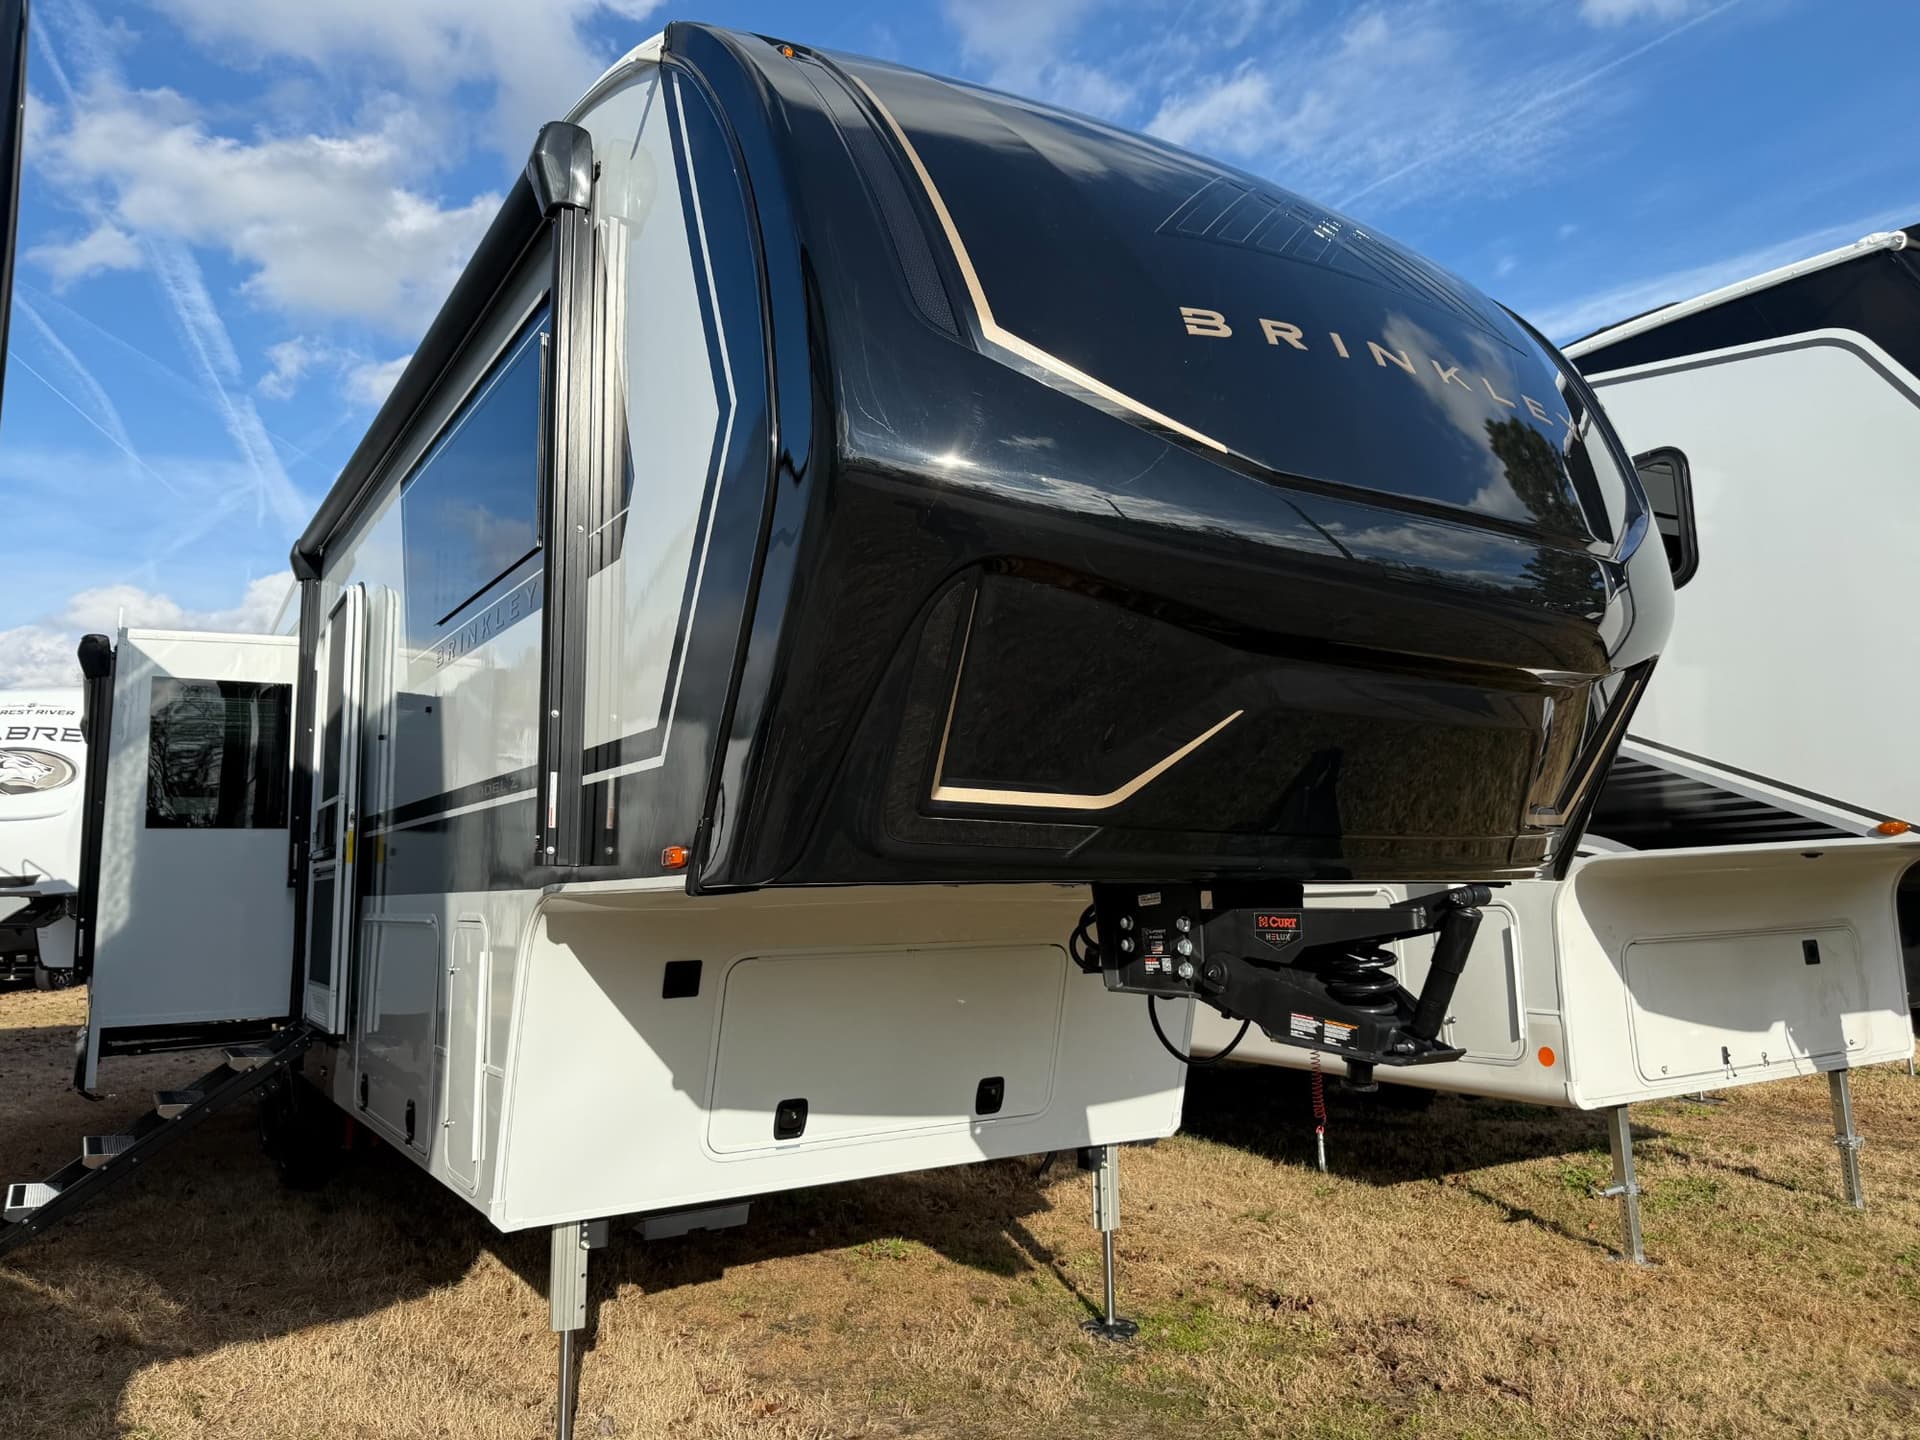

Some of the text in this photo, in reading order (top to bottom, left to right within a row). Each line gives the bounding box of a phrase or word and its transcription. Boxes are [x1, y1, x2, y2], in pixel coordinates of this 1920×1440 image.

[1179, 306, 1581, 442] BRINKLEY
[435, 582, 538, 669] BRINKLEY
[35, 709, 76, 717] RIVER
[0, 726, 83, 742] BRE
[1269, 916, 1297, 928] CURT
[1265, 932, 1291, 942] HELUX
